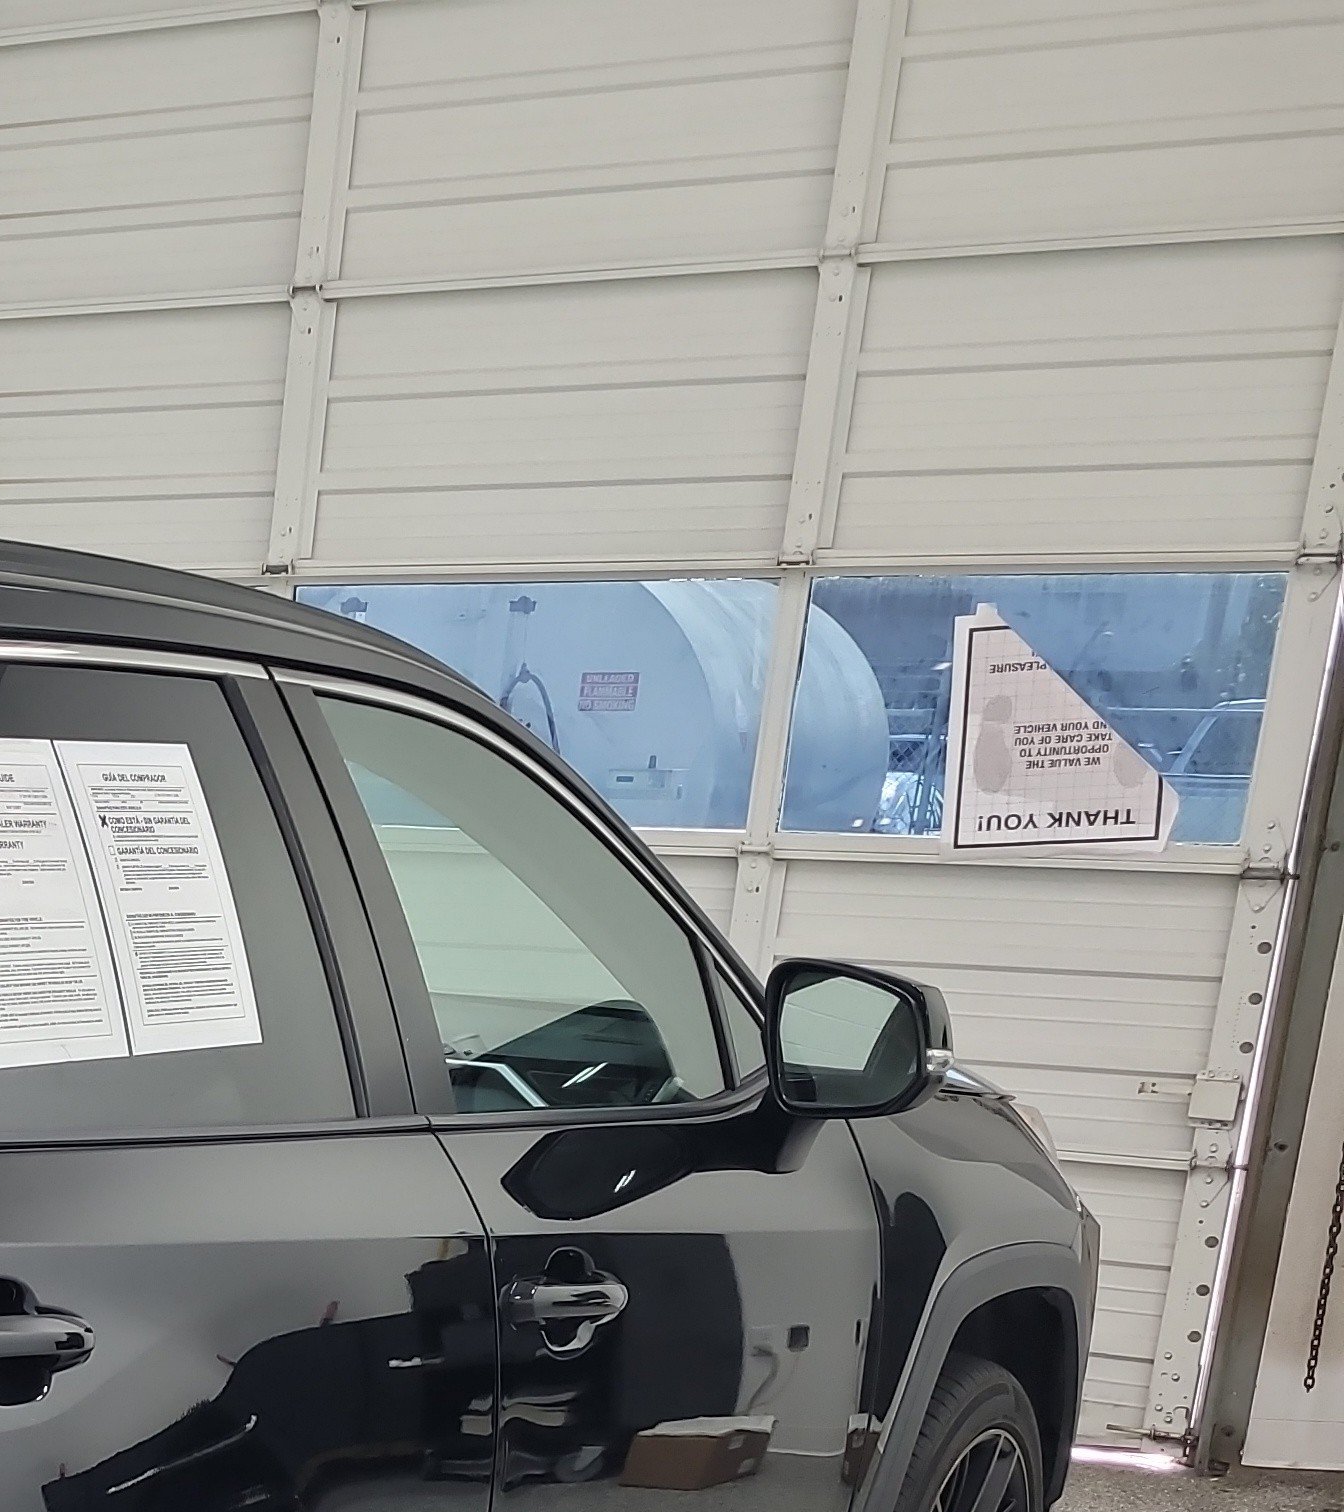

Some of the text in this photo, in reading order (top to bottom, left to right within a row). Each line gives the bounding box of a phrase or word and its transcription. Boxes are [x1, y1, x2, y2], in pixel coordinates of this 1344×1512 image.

[989, 661, 1047, 674] PLEASURE
[1013, 721, 1108, 734] ND YOUR VEHICLE
[1014, 732, 1113, 747] TAKE CARE OF YOU
[1019, 744, 1110, 758] OPPORTUNITY TO
[1025, 757, 1101, 770] WE VALUE THE
[978, 808, 1136, 832] THANK YOU!
